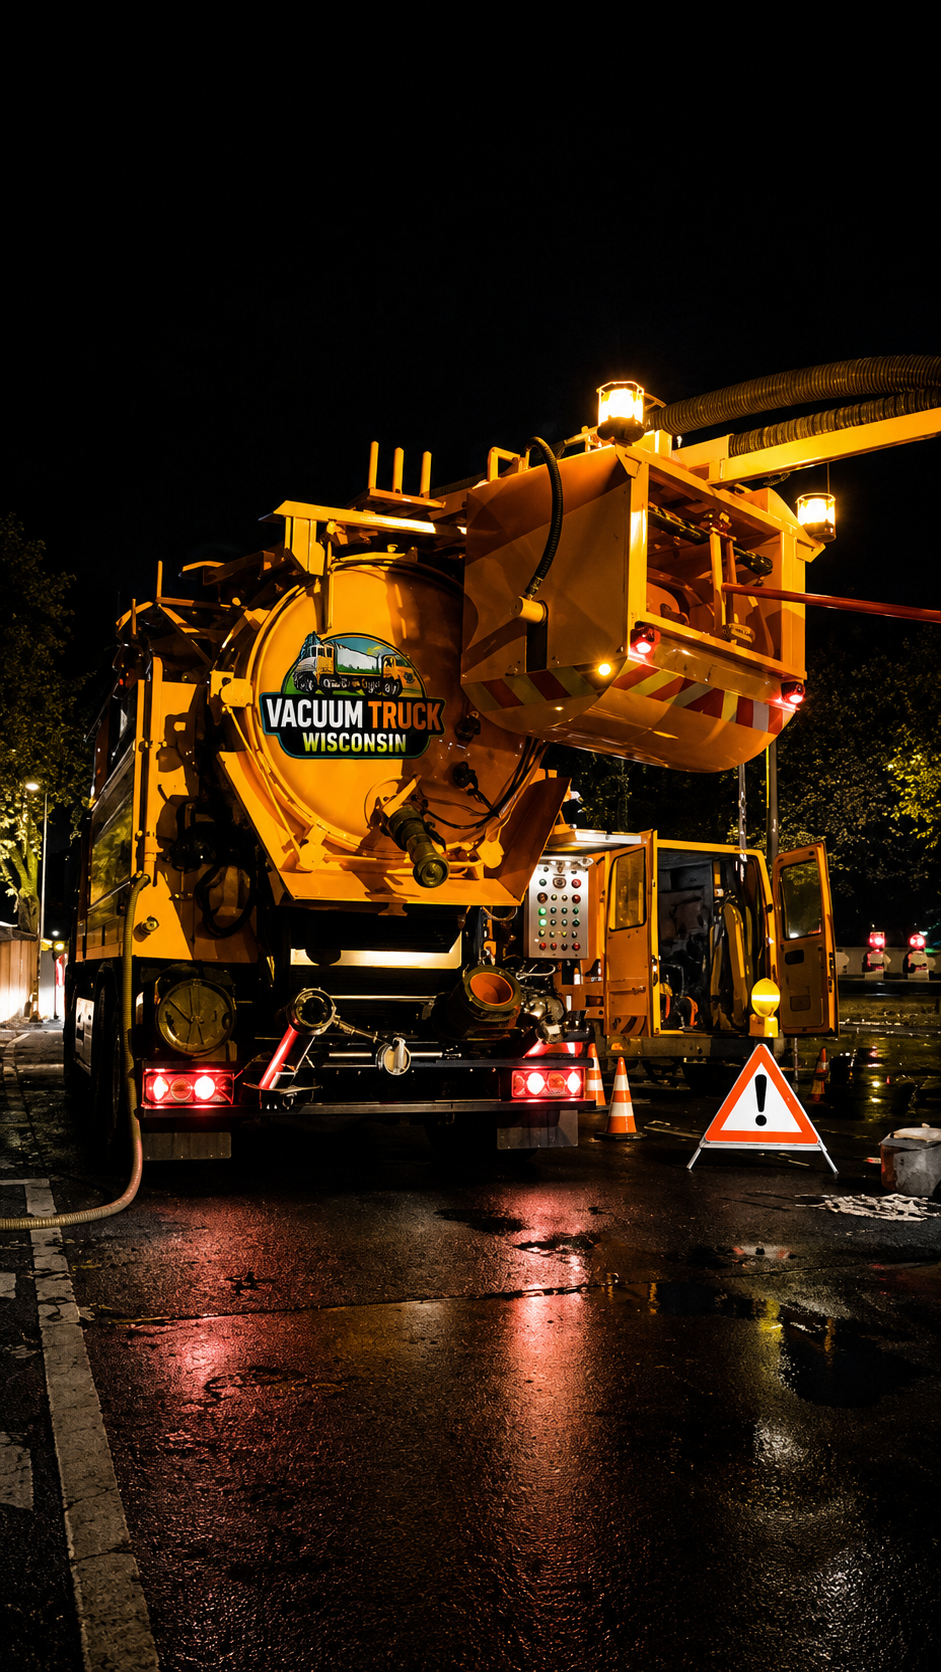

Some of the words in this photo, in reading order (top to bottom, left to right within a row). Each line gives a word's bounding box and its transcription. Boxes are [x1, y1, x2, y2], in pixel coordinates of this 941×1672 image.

[266, 698, 363, 729] VACUUM
[368, 700, 441, 731] TRUCK
[302, 732, 406, 753] WISCONSIN
